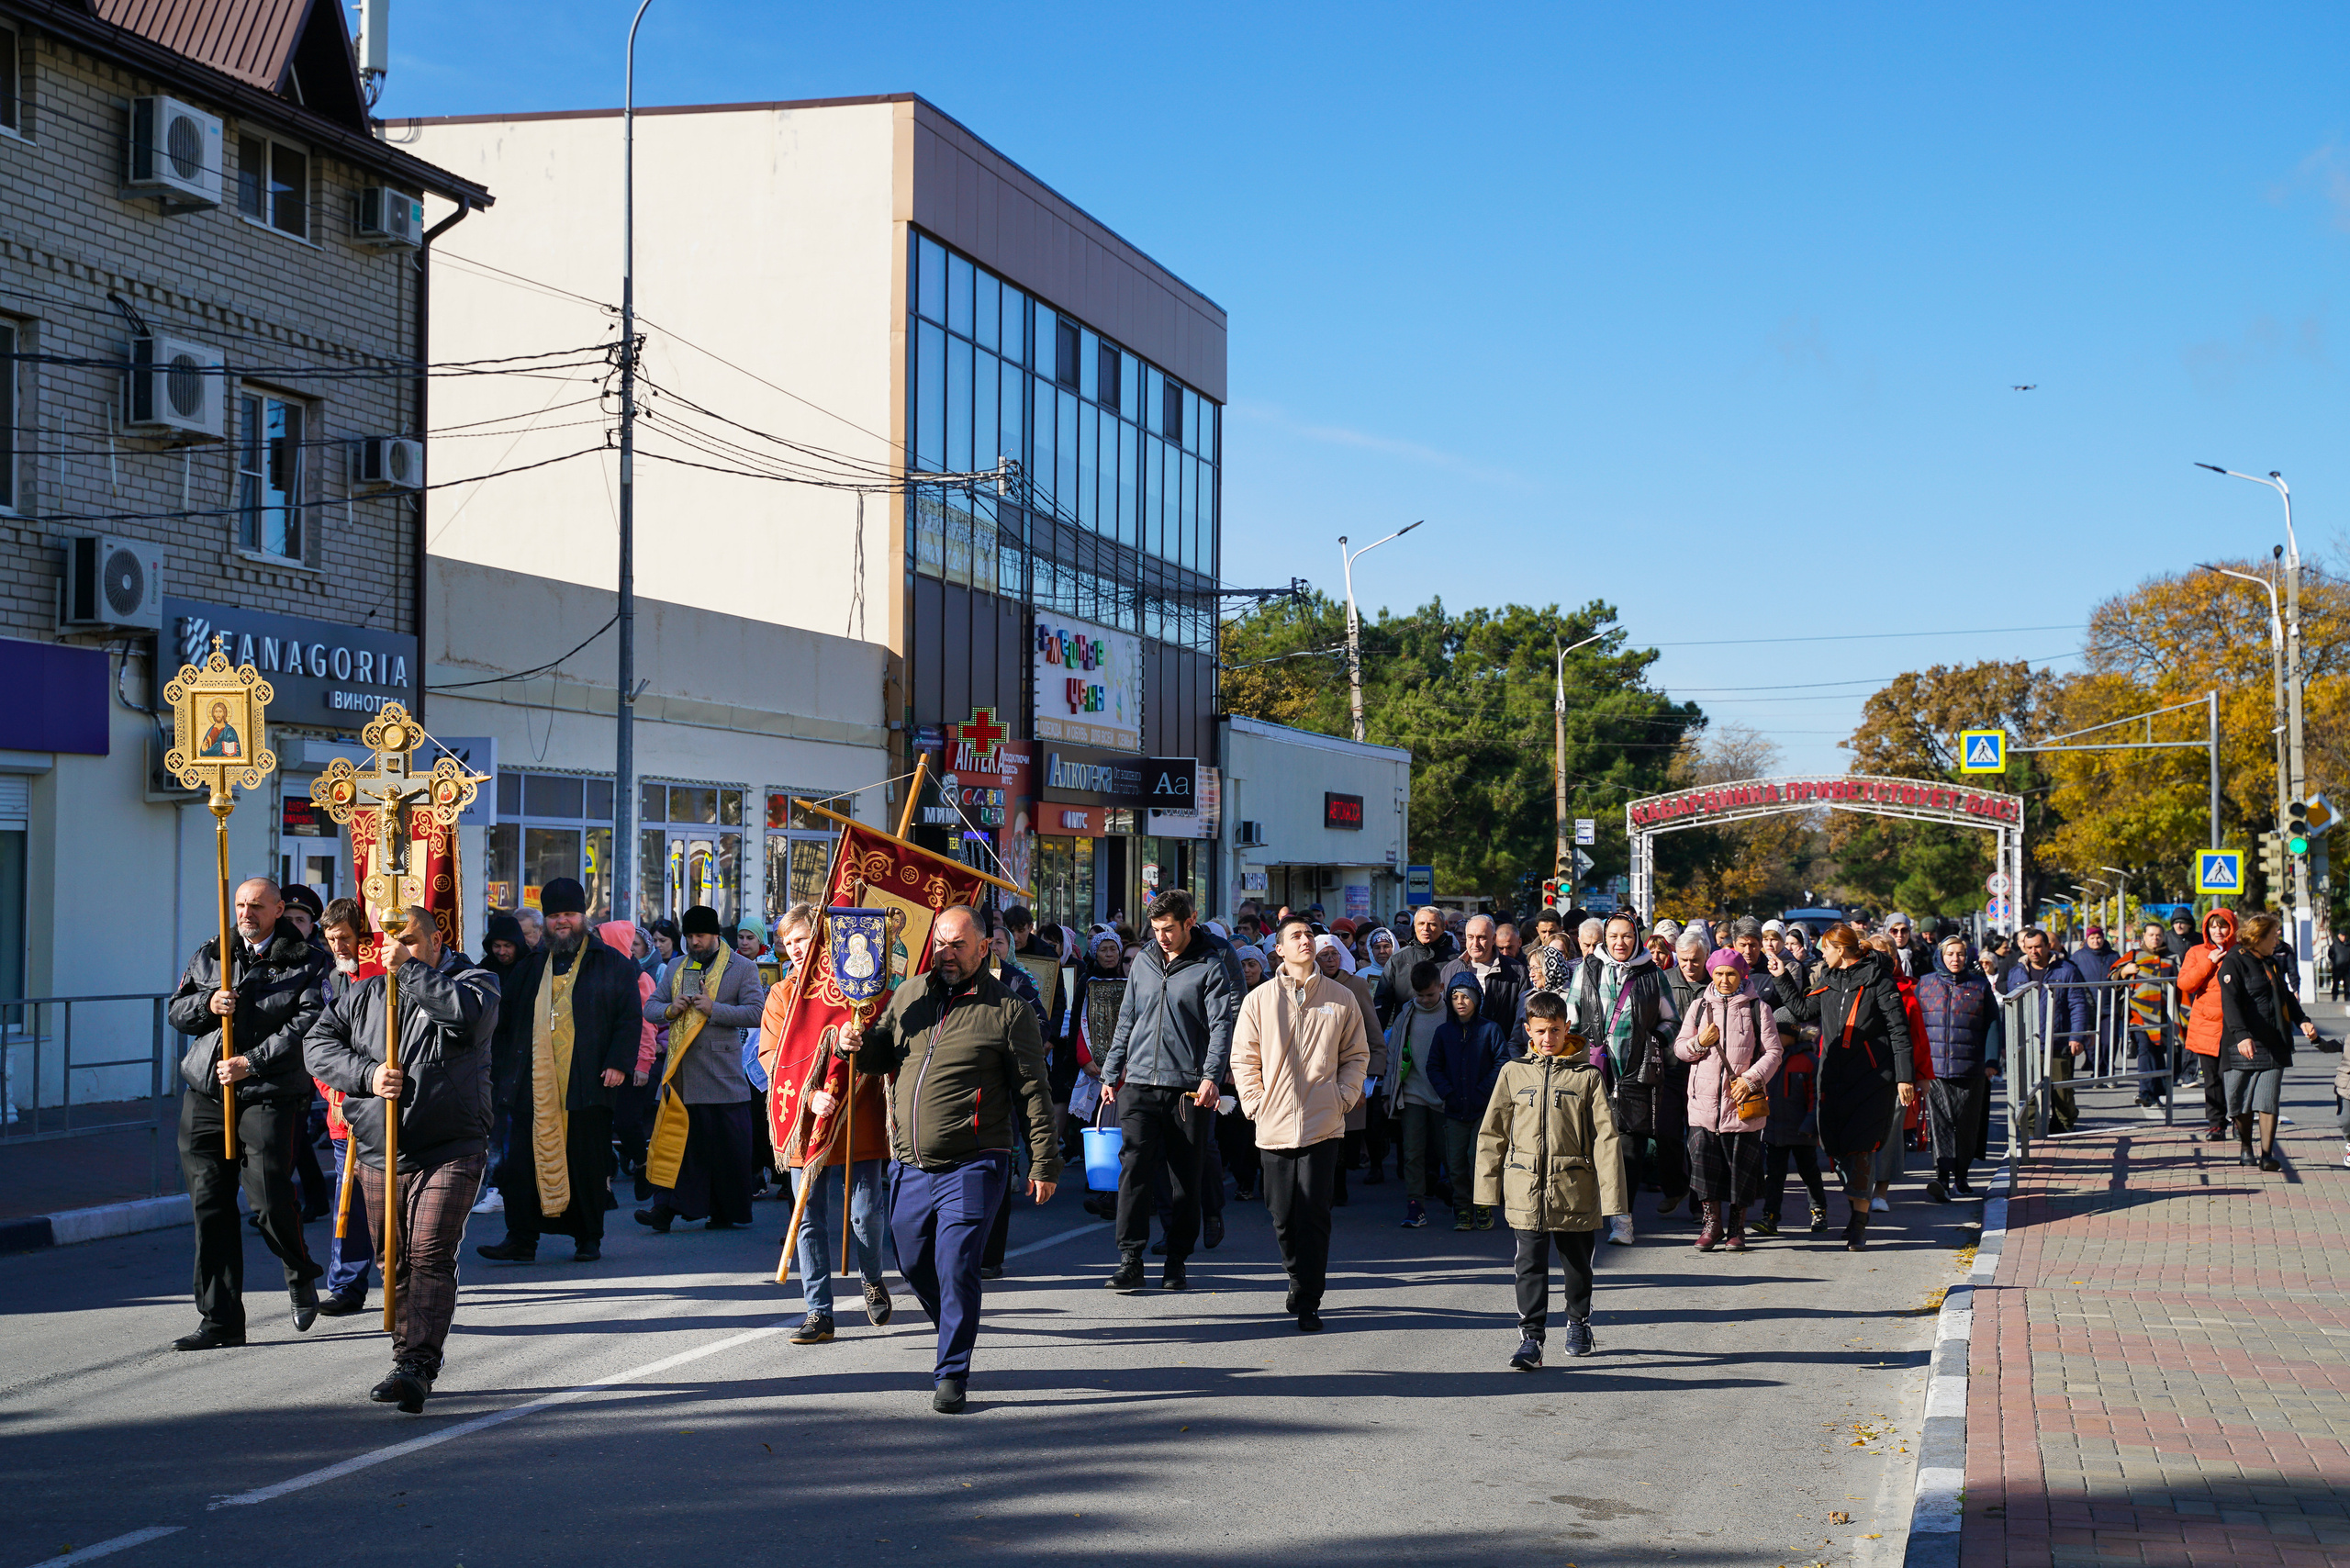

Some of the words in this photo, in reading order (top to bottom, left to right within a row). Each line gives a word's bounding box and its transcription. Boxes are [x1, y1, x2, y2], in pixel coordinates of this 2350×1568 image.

[218, 630, 408, 688] FANAGORIA
[1039, 720, 1062, 738] ОДЕЖДА
[1071, 725, 1088, 742] ОБУВЬ
[1091, 728, 1101, 745] ДЛЯ
[1102, 729, 1114, 745] ВСЕЙ
[1118, 733, 1134, 748] СЕМЬИ
[1003, 764, 1019, 776] ДЕСЬ
[1049, 753, 1113, 794] Алкотека
[1329, 801, 1360, 822] АВТОКАССА
[1631, 783, 1779, 825] КАБАРДИНКА
[1786, 780, 1959, 810] ПРИВЕТСТВУЕТ
[1965, 793, 2019, 823] ВАС!
[1071, 812, 1088, 829] МТС
